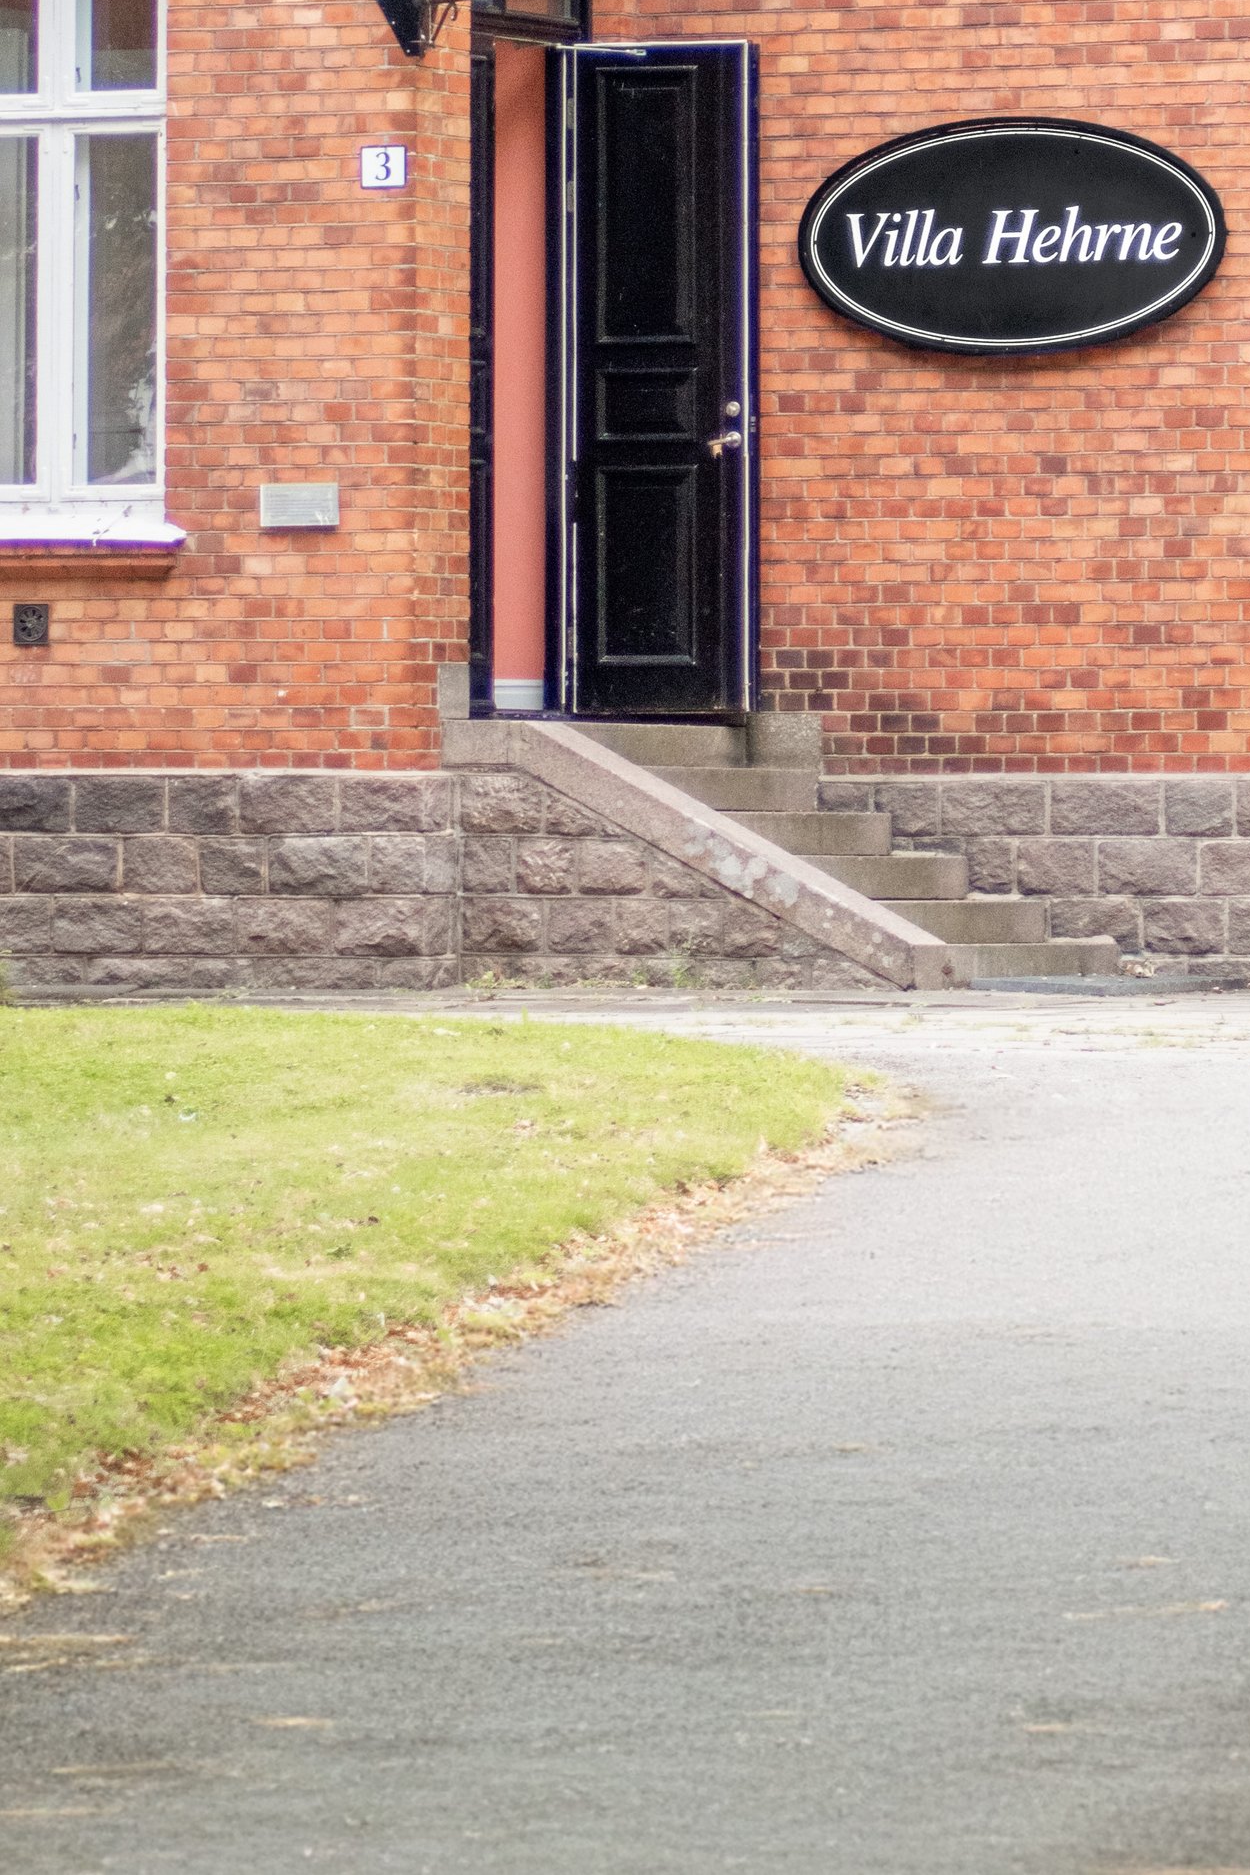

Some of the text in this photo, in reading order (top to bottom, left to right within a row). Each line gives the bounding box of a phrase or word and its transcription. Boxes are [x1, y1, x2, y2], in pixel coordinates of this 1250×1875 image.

[375, 151, 391, 181] 3
[846, 205, 1183, 268] Villa Hehrne
